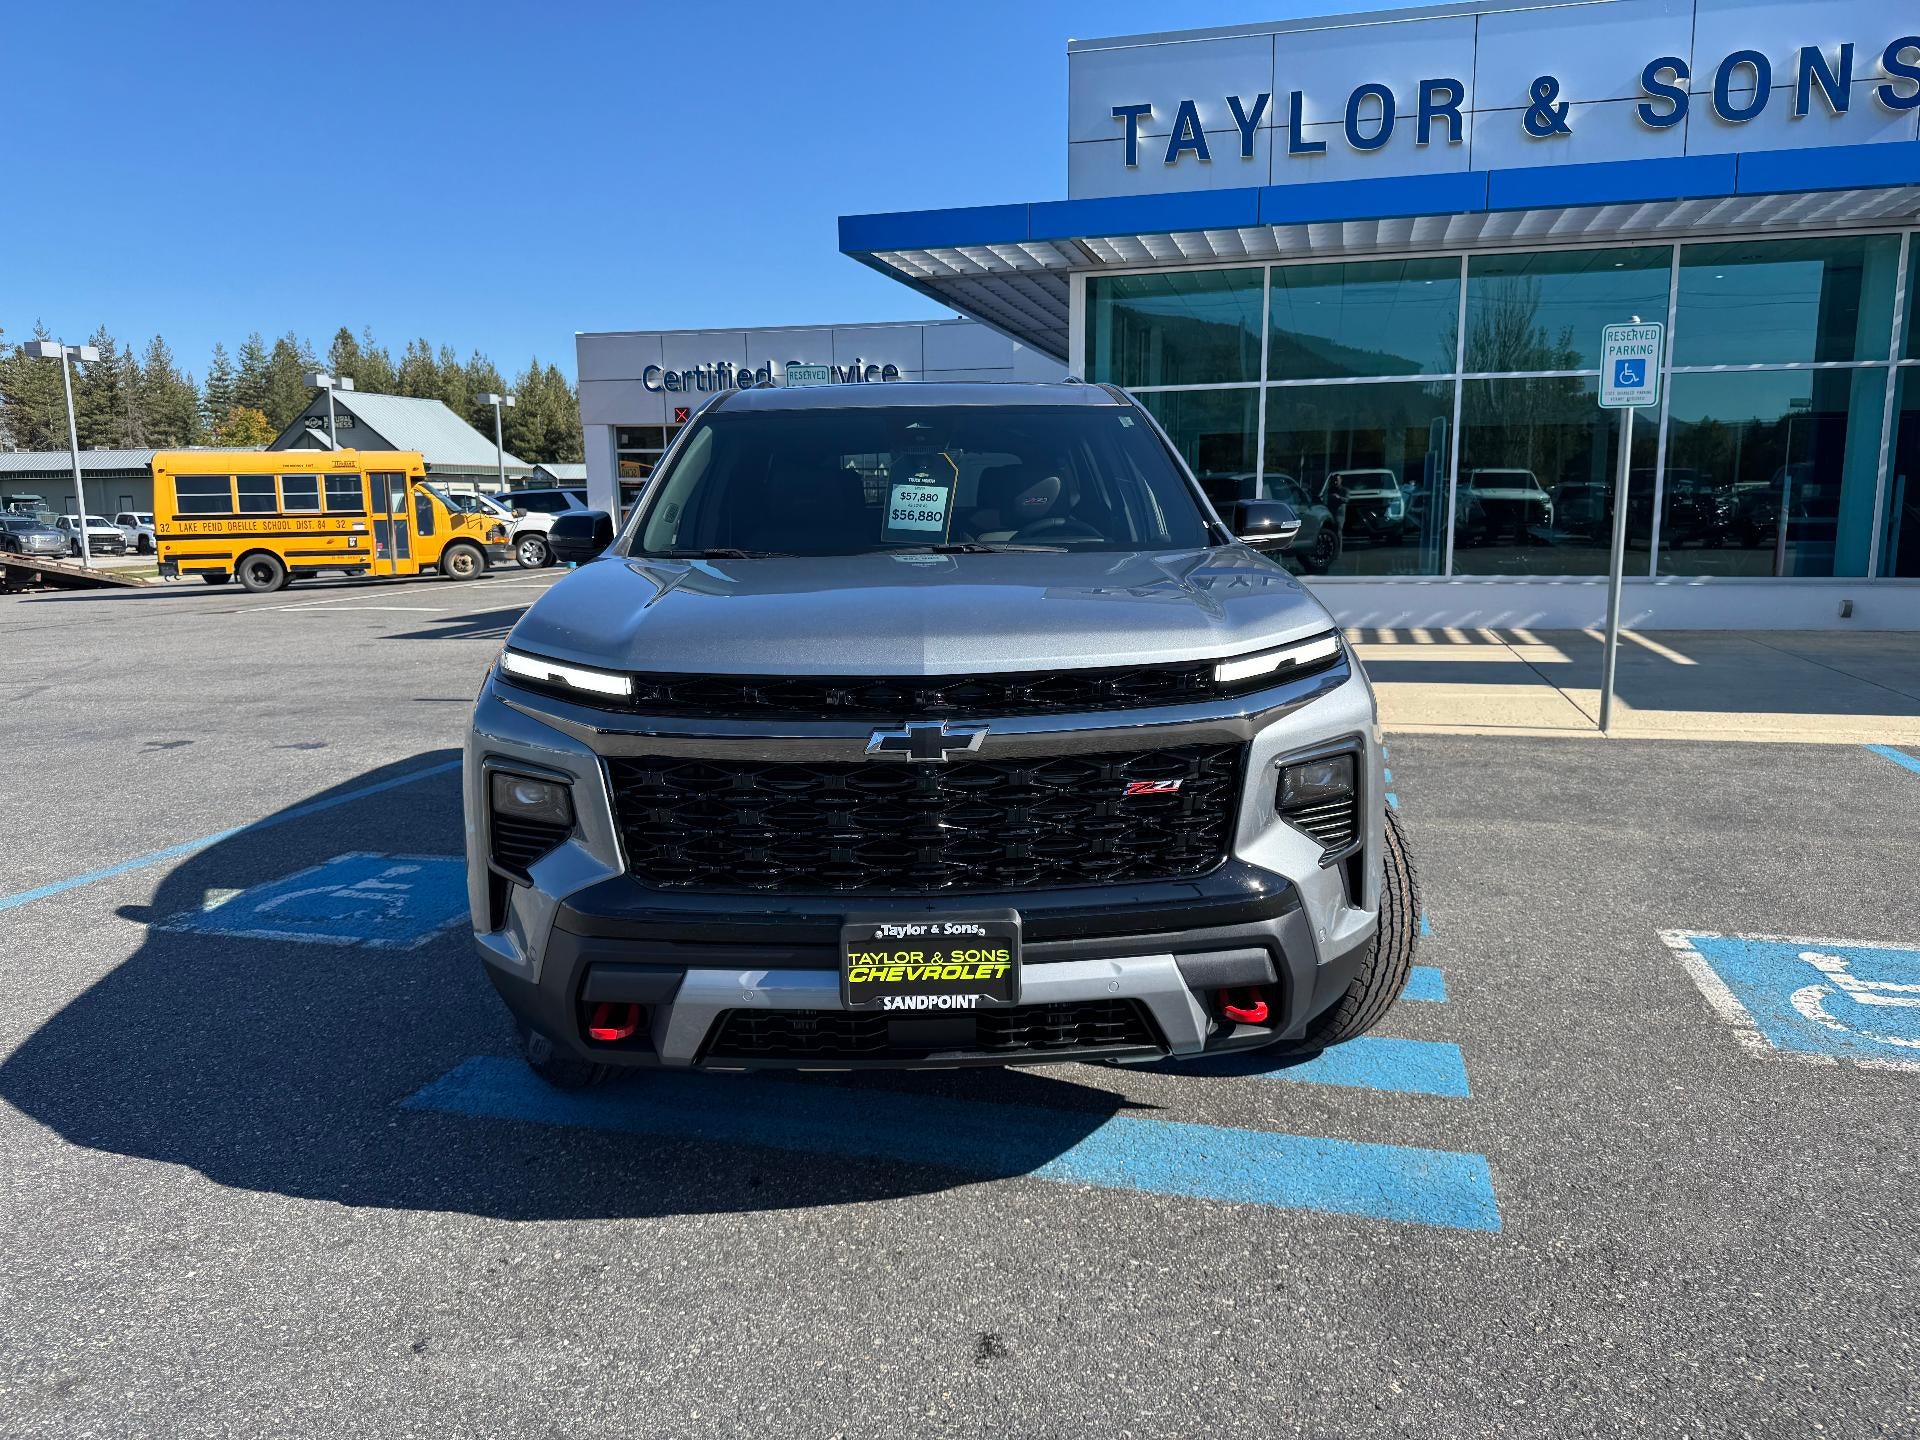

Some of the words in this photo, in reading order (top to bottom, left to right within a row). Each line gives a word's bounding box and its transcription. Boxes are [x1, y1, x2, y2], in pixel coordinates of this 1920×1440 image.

[1111, 77, 1465, 167] TAYLOR
[1521, 74, 1573, 139] &
[1635, 35, 1920, 130] SONS
[1607, 330, 1657, 342] RESERVED
[1609, 345, 1653, 356] PARKING
[642, 359, 773, 393] Certified
[789, 370, 826, 381] RESERVED
[900, 492, 938, 502] $57,880
[892, 509, 942, 522] $56,880
[160, 523, 170, 533] 32
[179, 522, 198, 533] LAKE
[202, 522, 222, 532] PEND
[228, 521, 257, 532] OREILLE
[263, 521, 292, 531] SCHOOL
[296, 520, 315, 530] DIST.
[317, 520, 326, 529] 84
[336, 519, 346, 529] 32
[880, 923, 928, 939] Taylor
[930, 924, 940, 934] &
[944, 922, 979, 935] Sons
[848, 951, 924, 965] TAYLOR
[931, 951, 944, 965] &
[950, 949, 1010, 963] SONS
[848, 964, 1011, 983] CHEVROLET
[883, 994, 980, 1011] SANDPOINT
